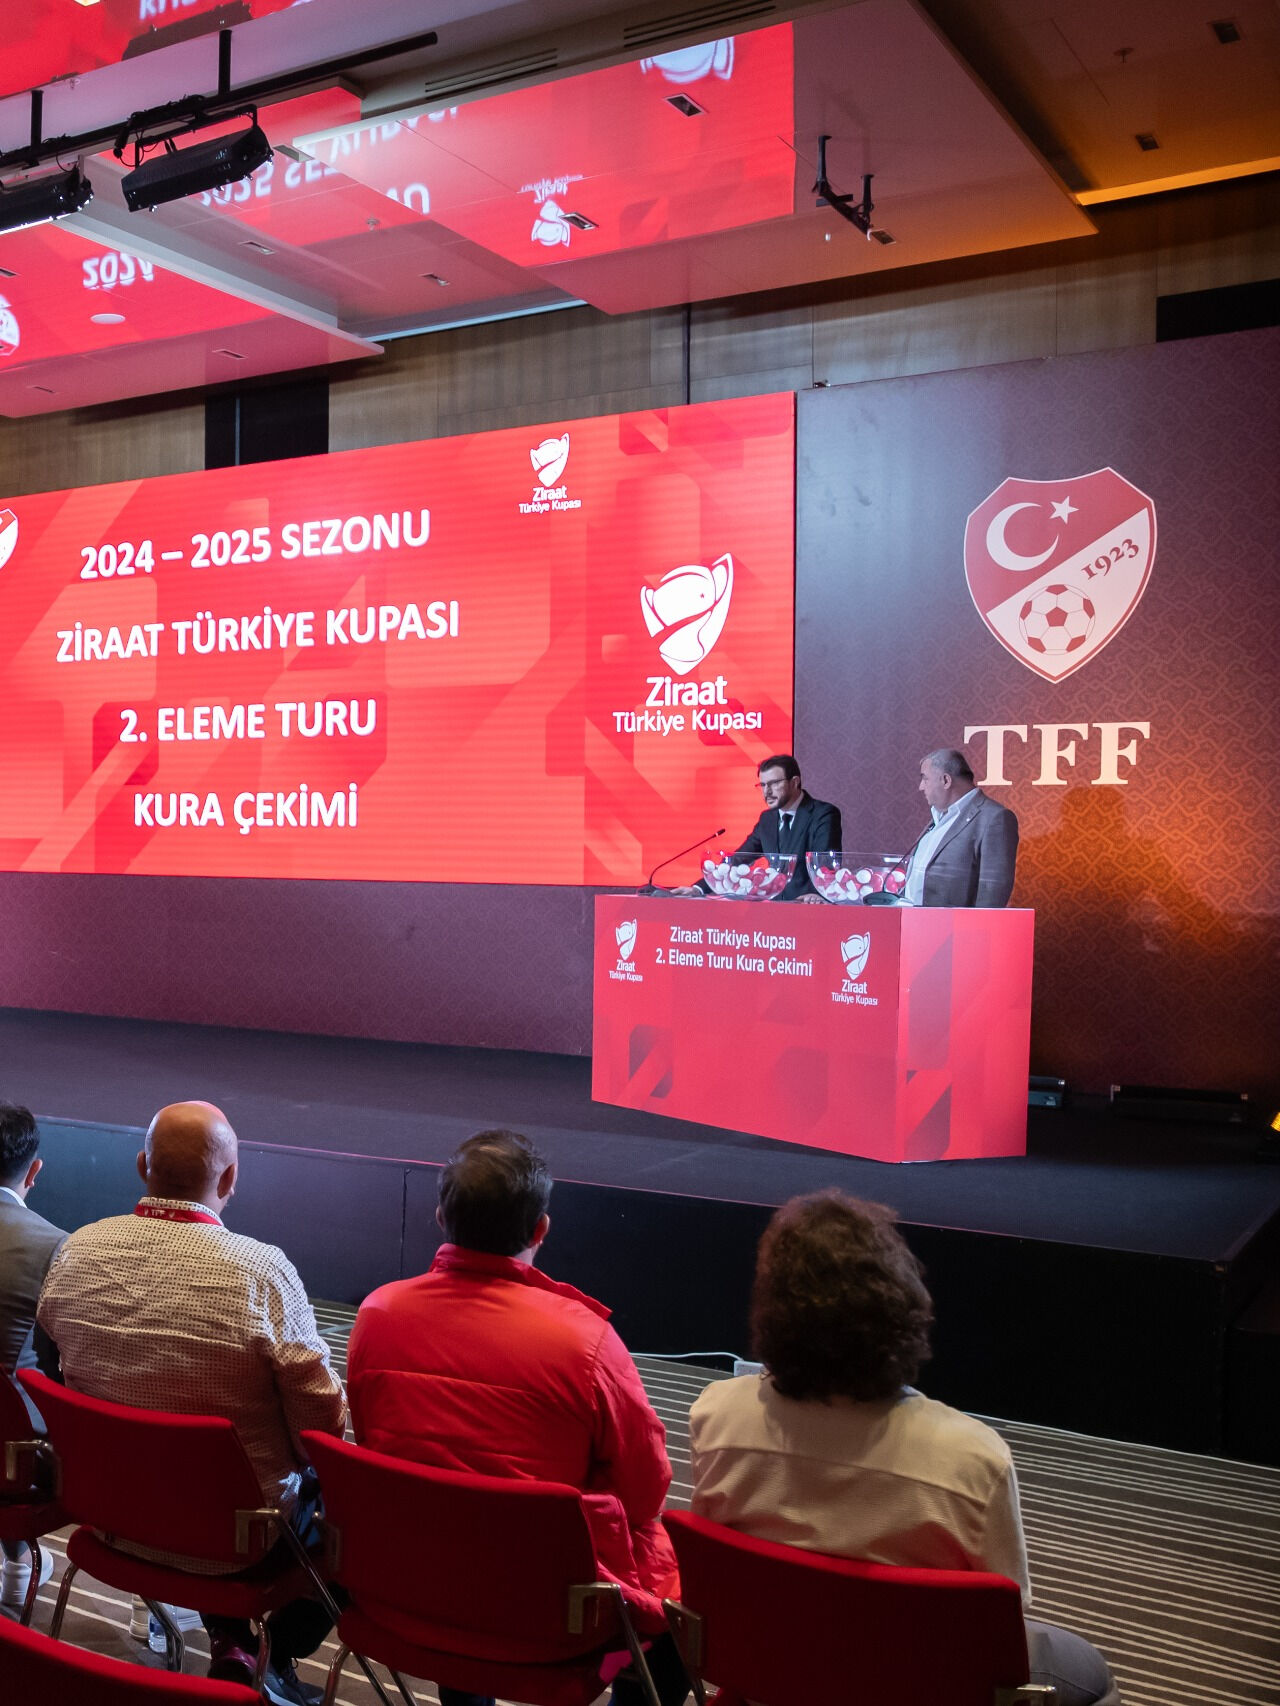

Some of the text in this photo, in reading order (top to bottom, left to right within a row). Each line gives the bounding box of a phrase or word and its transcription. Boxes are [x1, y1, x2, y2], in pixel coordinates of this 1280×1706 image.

[519, 499, 582, 514] Türkiye Kupası
[532, 485, 568, 502] Ziraat
[80, 540, 155, 580] 2024
[190, 527, 271, 568] 2025
[280, 509, 431, 560] SEZONU
[1081, 538, 1140, 581] 1923
[56, 600, 460, 663] ZİRAAT TÜRKİYE KUPASI
[645, 675, 728, 707] Ziraat
[119, 699, 376, 742] 2. ELEME TURU
[612, 709, 762, 737] Türkiye Kupası
[963, 721, 1151, 786] TFF
[134, 782, 358, 835] KURA ÇEKİMİ
[670, 926, 796, 952] Ziraat Türkiye Kupası
[616, 959, 636, 972] Ziraat
[655, 948, 813, 977] 2. Eleme Turu Kura Çekimi
[831, 992, 878, 1006] Türkiye Kupası
[841, 979, 867, 994] Ziraat
